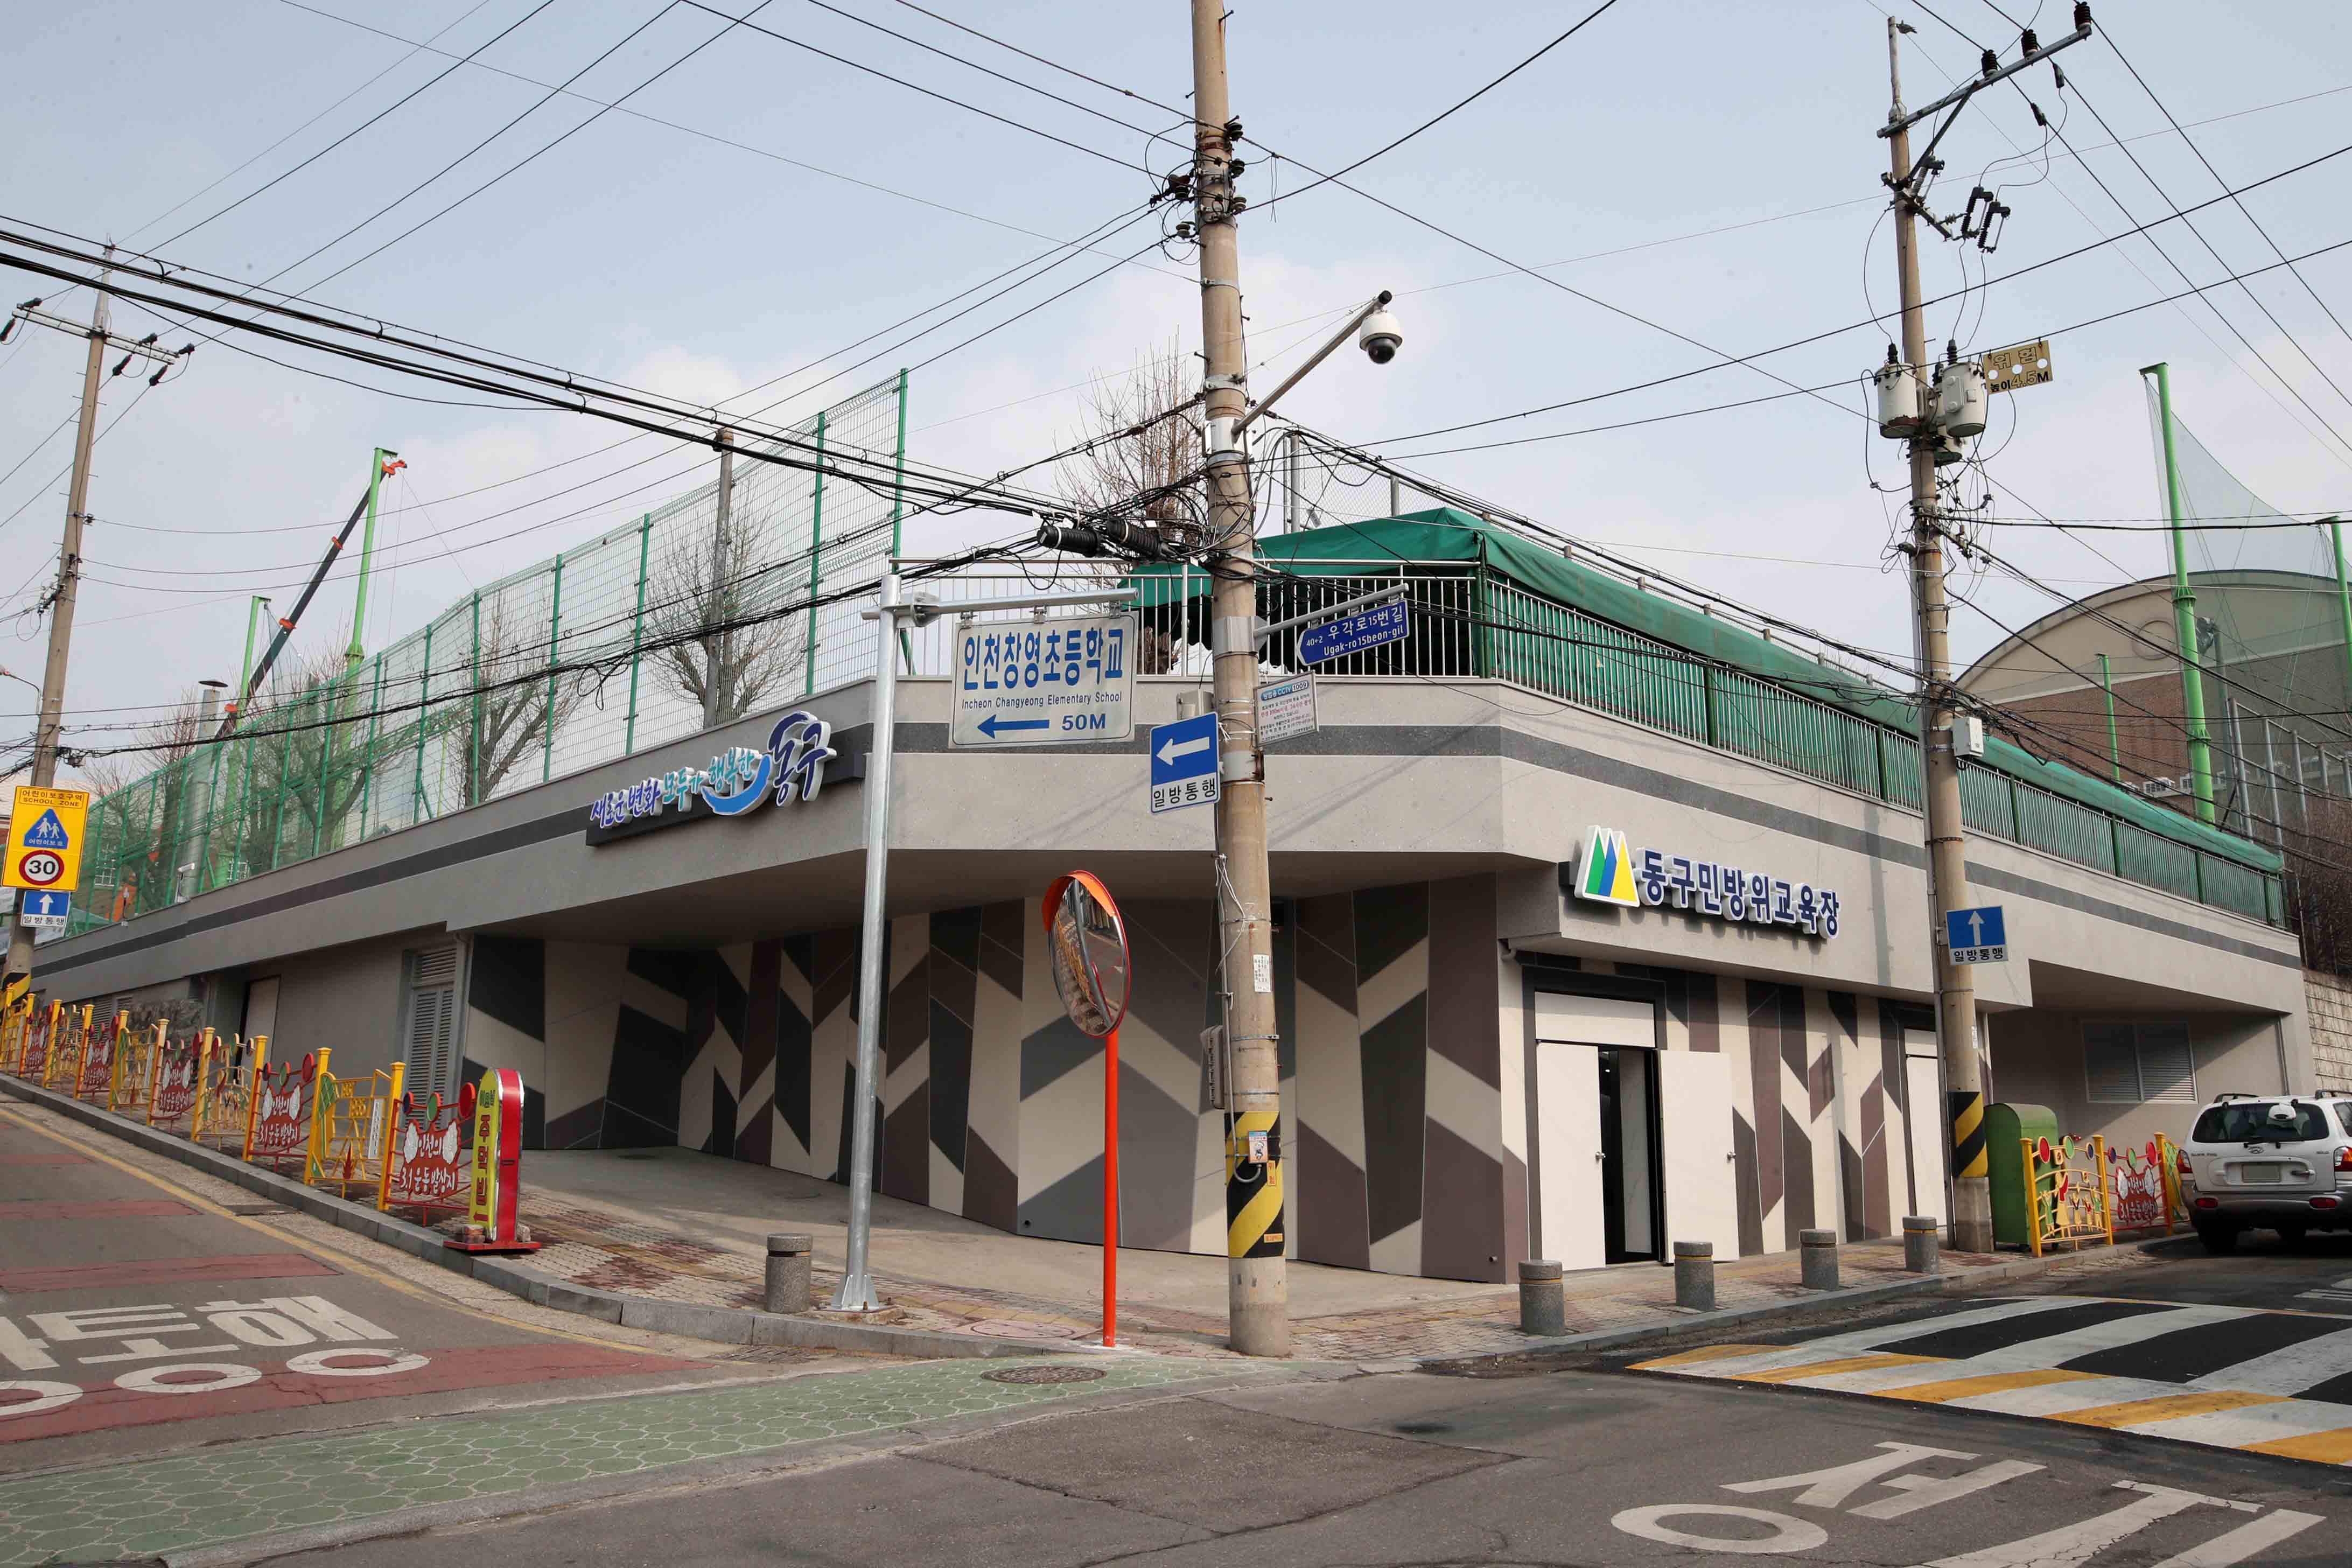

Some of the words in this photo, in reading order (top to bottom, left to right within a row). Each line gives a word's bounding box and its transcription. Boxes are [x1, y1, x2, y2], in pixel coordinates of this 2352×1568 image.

[1993, 346, 2038, 370] 위험
[1324, 639, 1357, 656] Ugak-ro
[1357, 624, 1404, 646] 15beon-gil
[963, 626, 1124, 690] 인천창영초등학교
[1292, 682, 1307, 690] 1009
[962, 696, 992, 710] Incheon
[995, 695, 1044, 709] Changyeong
[1047, 693, 1091, 706] Elementary
[1095, 691, 1122, 703] School
[1061, 713, 1107, 732] 50M
[590, 793, 626, 828] 새로운
[627, 776, 661, 817] 변화
[662, 770, 704, 811] 모두가
[707, 746, 755, 796] 행복한
[767, 711, 834, 806] 동구
[22, 789, 83, 801] 어린이보호구역
[1153, 778, 1216, 808] 일방통행
[29, 860, 56, 875] 30
[1641, 848, 1840, 937] 동구민방위교육장
[1954, 947, 2004, 962] 일방통행
[418, 1133, 443, 1158] 인천의
